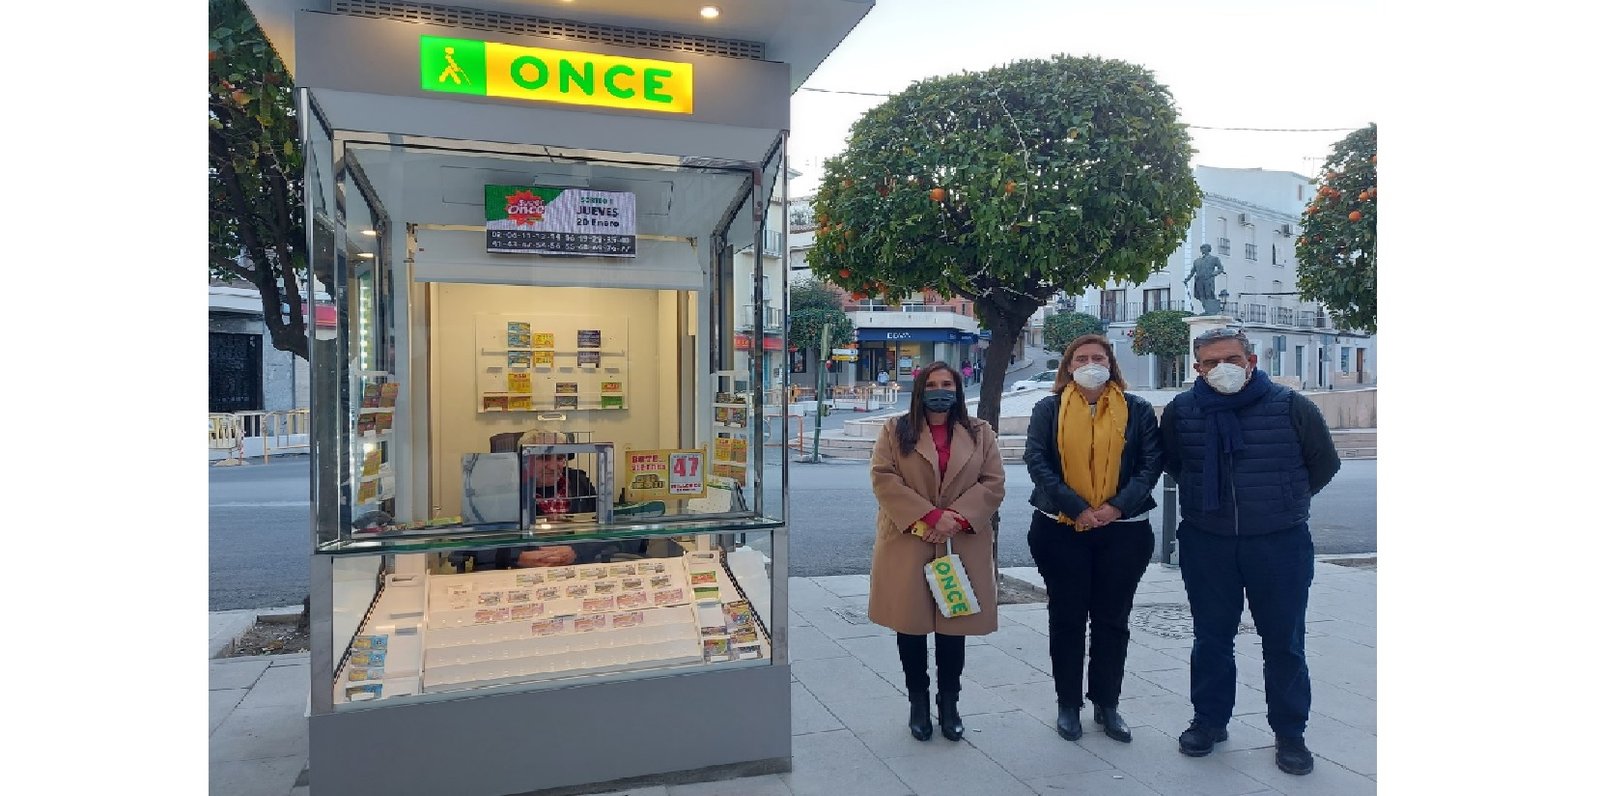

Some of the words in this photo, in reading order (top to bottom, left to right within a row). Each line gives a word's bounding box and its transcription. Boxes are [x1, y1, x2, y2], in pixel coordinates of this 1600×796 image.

[510, 55, 673, 103] ONCE
[576, 205, 619, 218] JUEVES
[576, 217, 588, 226] 20
[591, 218, 620, 227] Enero
[673, 457, 699, 476] 47
[935, 561, 968, 615] ONCE
